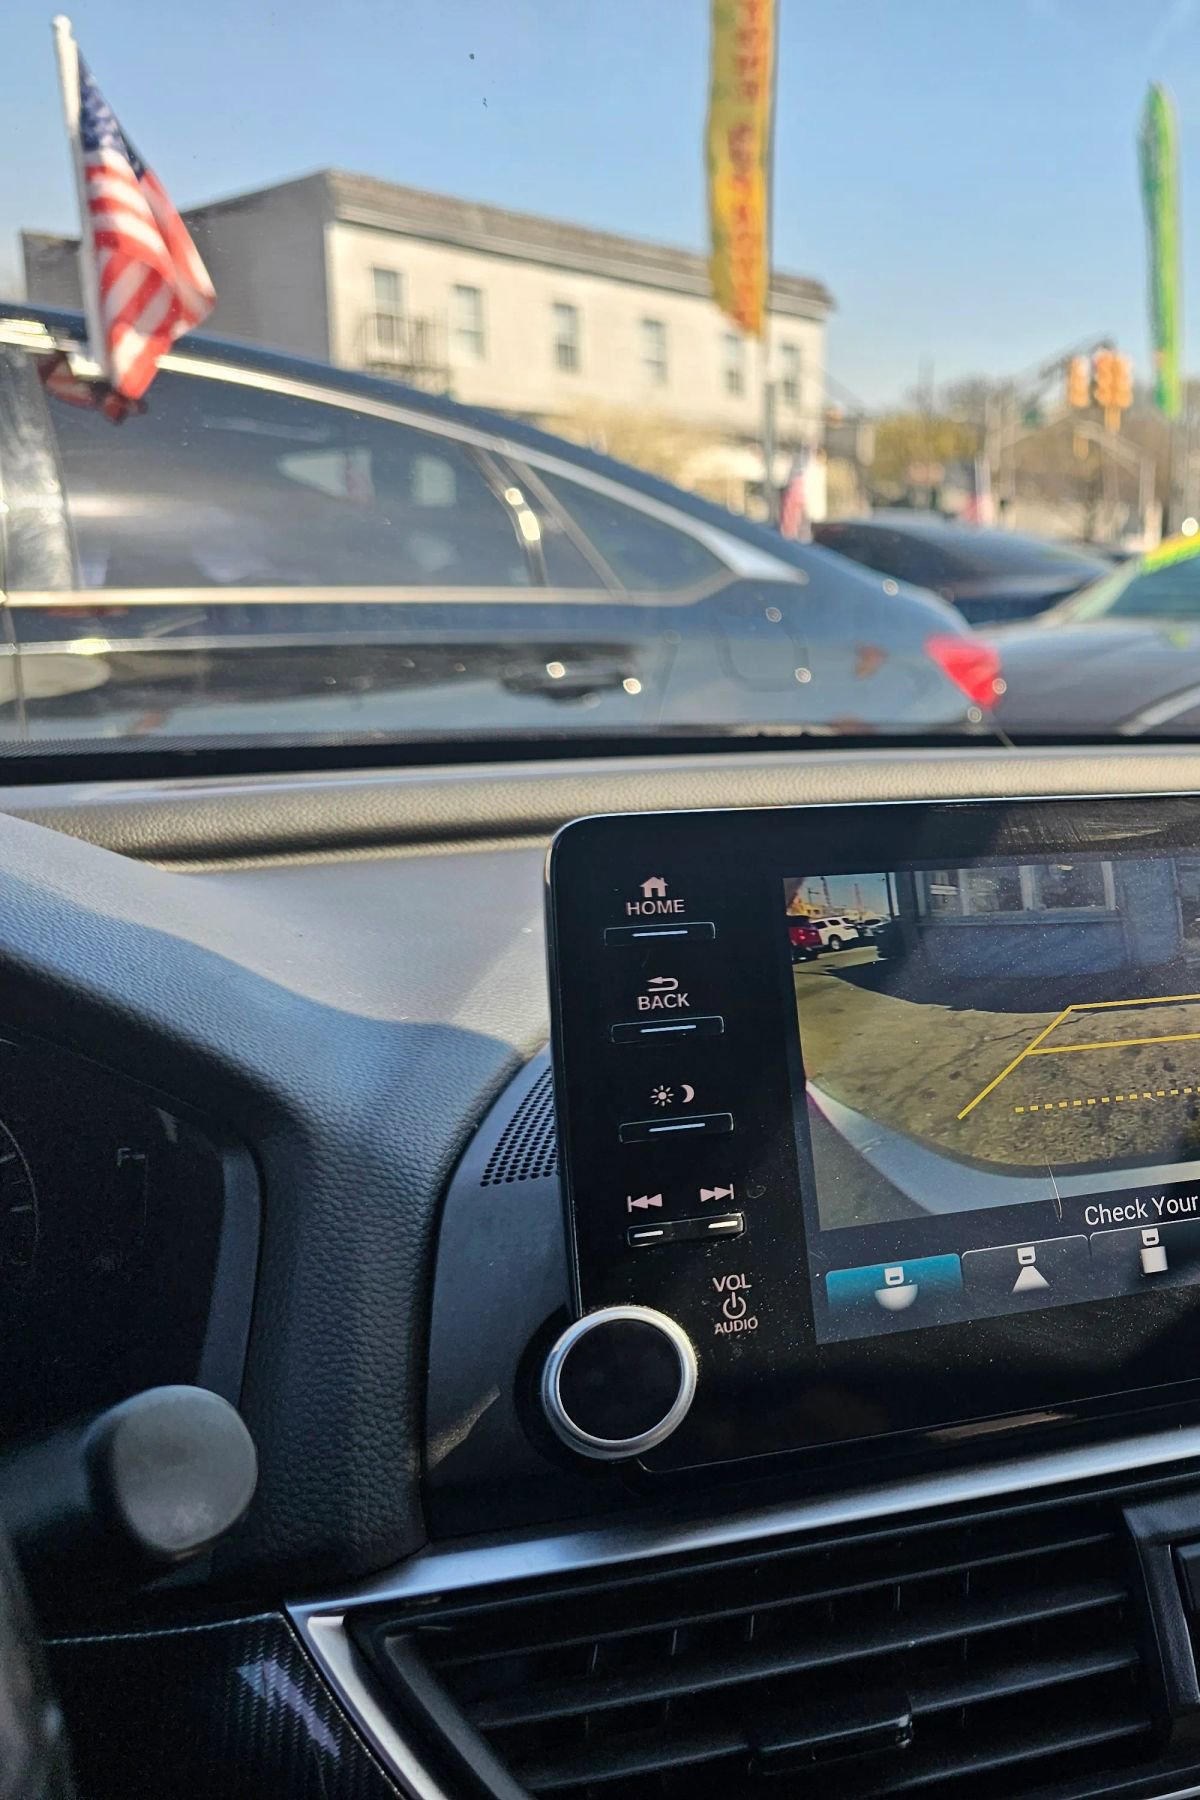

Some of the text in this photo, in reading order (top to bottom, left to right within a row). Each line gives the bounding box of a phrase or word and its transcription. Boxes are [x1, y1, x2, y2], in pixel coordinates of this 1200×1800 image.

[626, 899, 685, 916] HOME
[637, 992, 690, 1011] BACK
[1084, 1198, 1148, 1226] Check
[1151, 1194, 1199, 1216] Your
[712, 1274, 752, 1292] VOL
[714, 1317, 759, 1335] AUDIO
